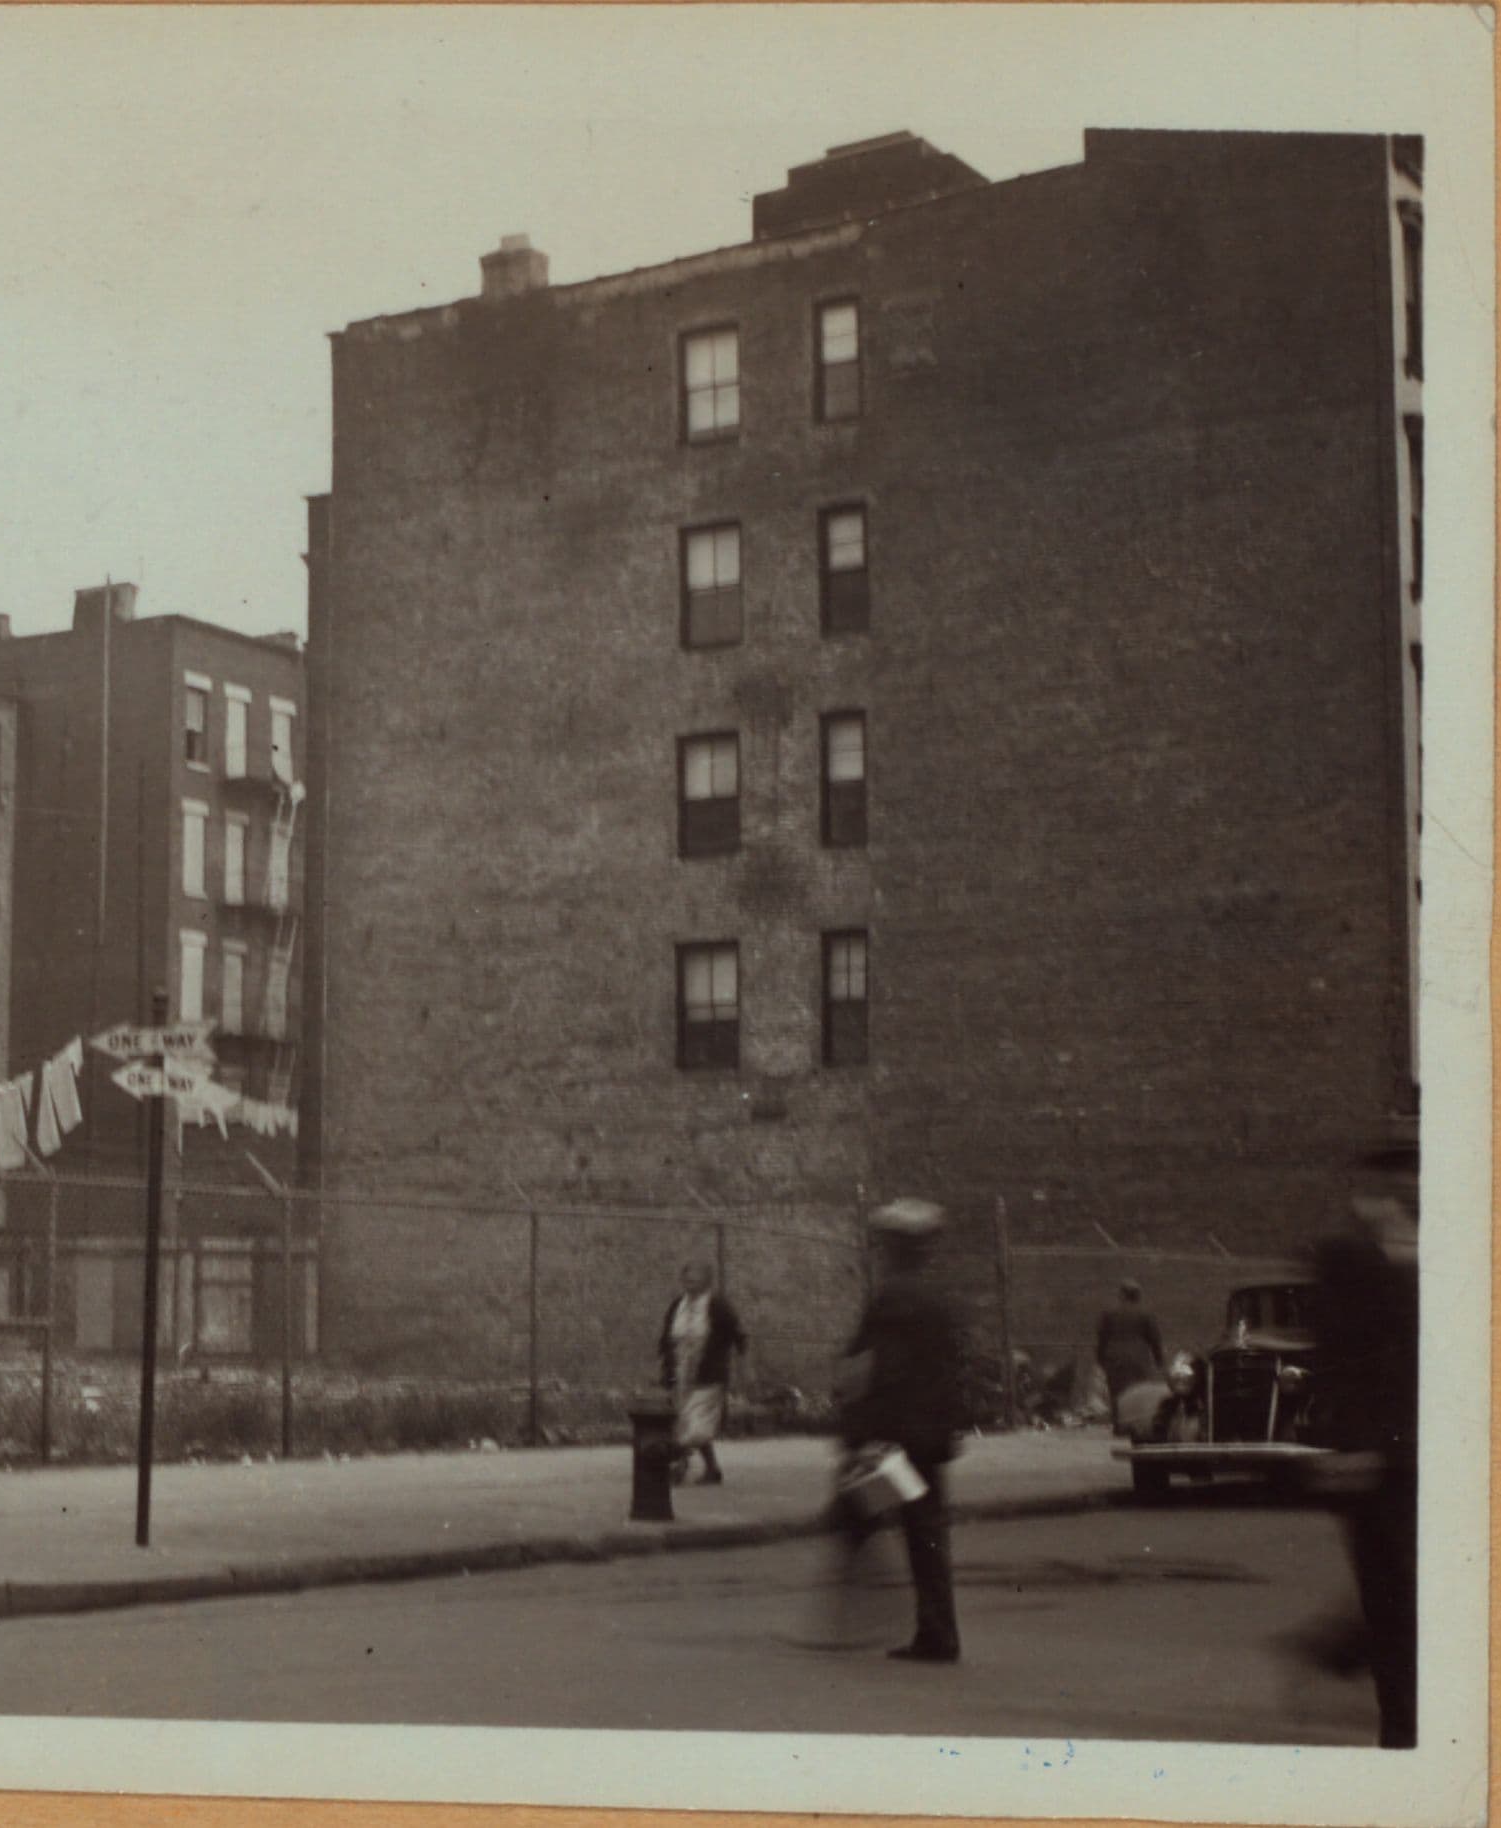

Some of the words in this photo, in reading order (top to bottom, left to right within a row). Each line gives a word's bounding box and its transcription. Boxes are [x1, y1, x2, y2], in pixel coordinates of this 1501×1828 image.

[108, 1033, 141, 1048] ONE
[162, 1034, 196, 1047] WAY
[127, 1073, 152, 1087] ONE
[168, 1076, 195, 1092] WAY
